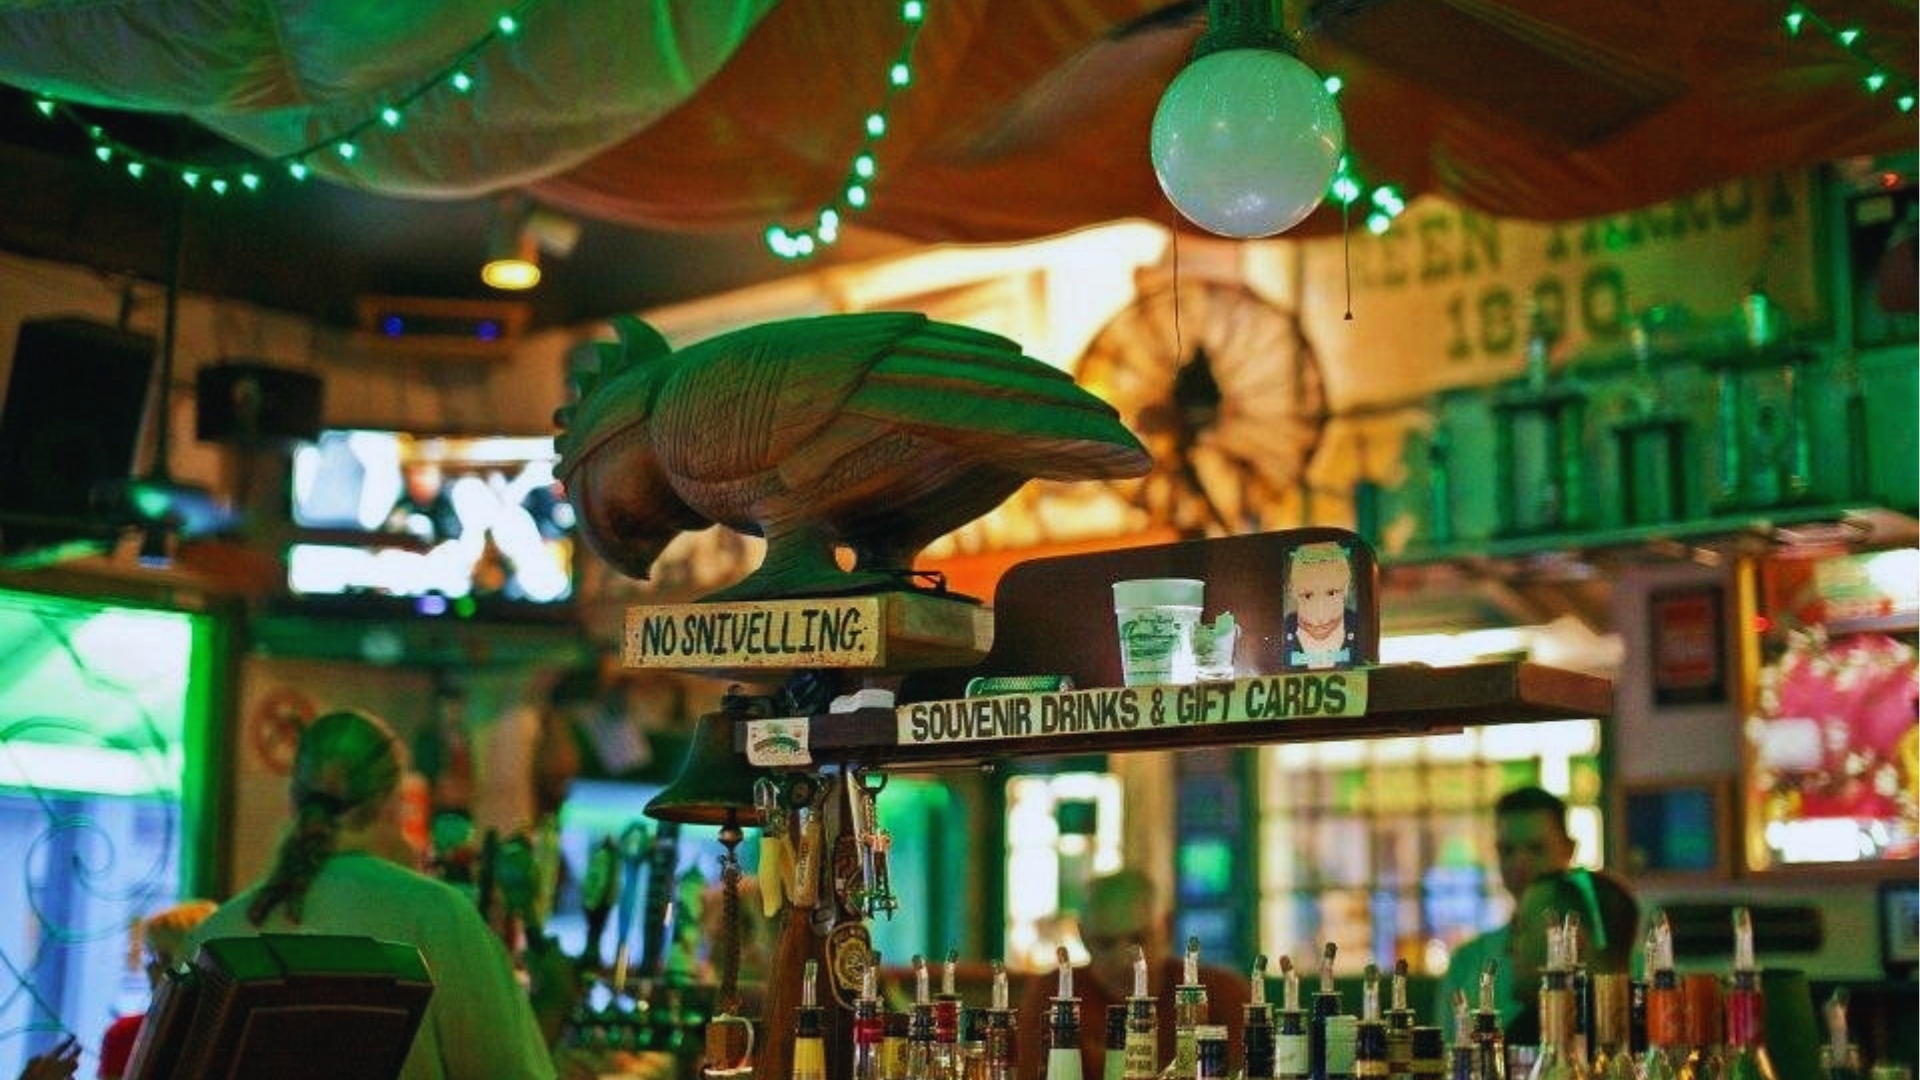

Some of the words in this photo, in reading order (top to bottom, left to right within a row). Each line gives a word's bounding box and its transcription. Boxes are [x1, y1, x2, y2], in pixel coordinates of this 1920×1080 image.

[641, 615, 676, 656] NO
[681, 606, 865, 656] SNIVELLING.
[911, 696, 1032, 741] SOUVENIR
[1041, 689, 1140, 733] DRINKS
[1151, 688, 1167, 726] &
[1176, 681, 1236, 724] GIFT
[1245, 674, 1347, 719] CARDS
